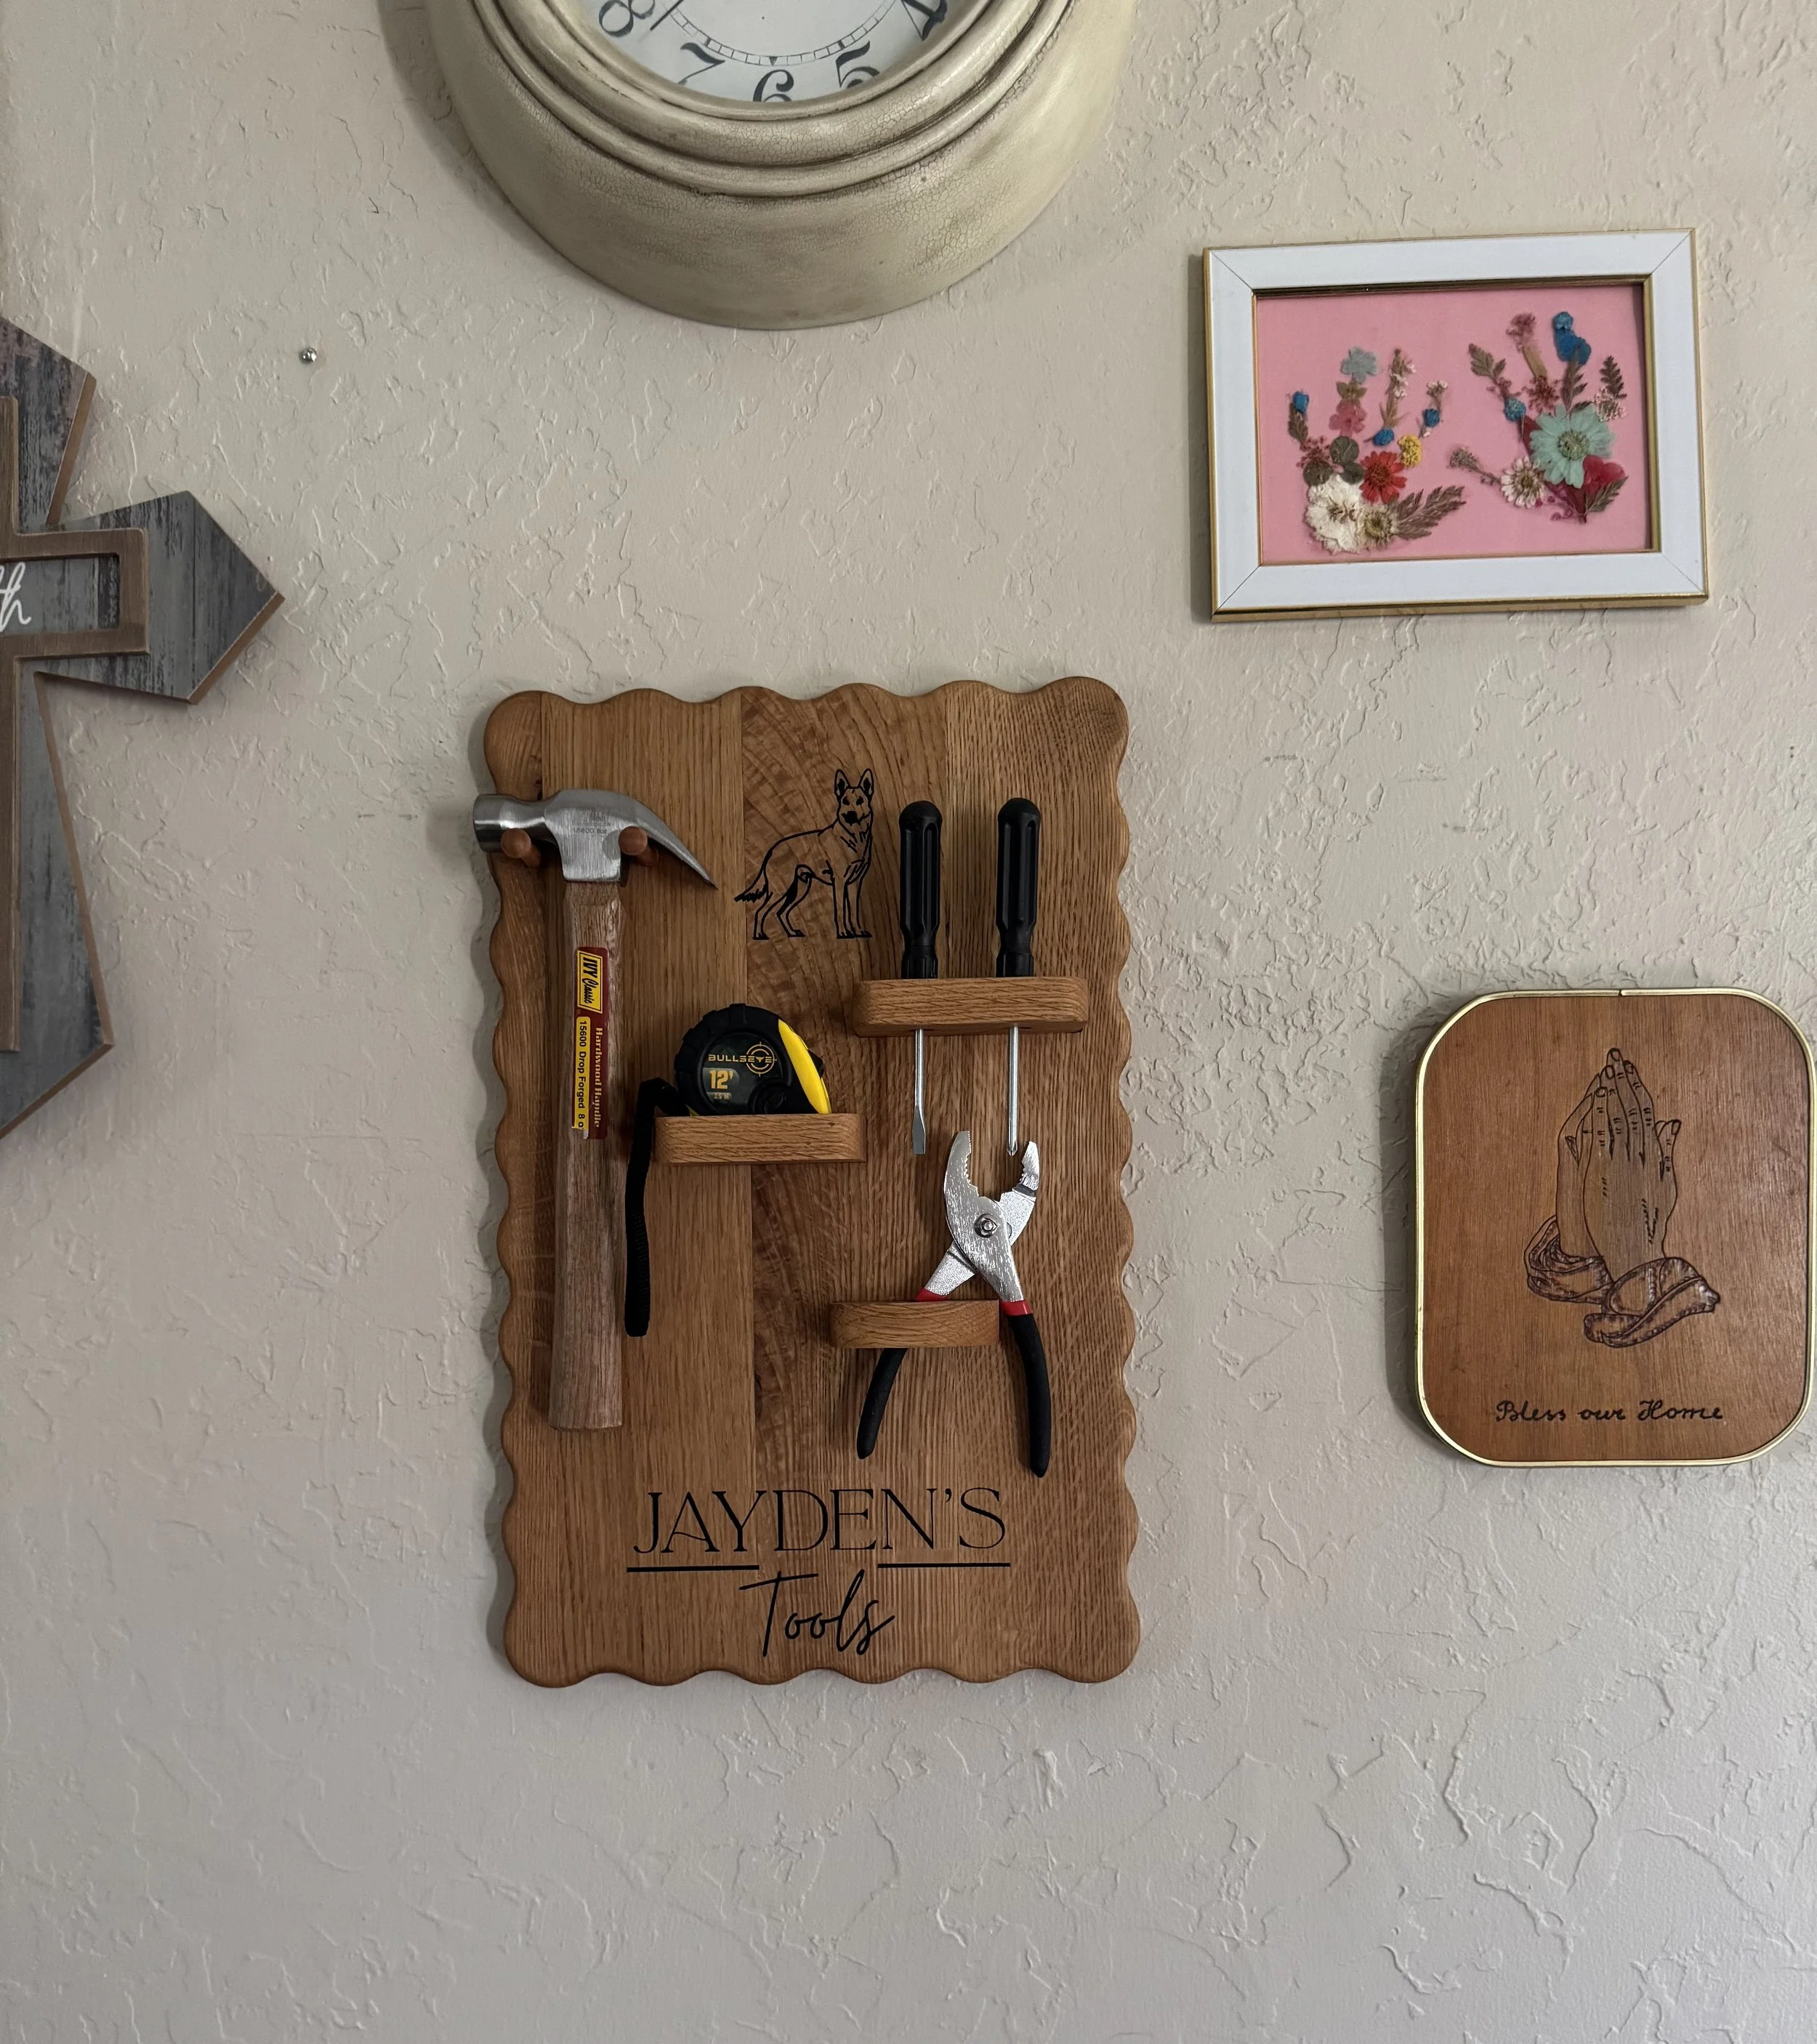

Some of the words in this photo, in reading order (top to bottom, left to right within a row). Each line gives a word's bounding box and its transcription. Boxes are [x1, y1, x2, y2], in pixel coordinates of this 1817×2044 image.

[599, 0, 656, 38] 8
[678, 42, 726, 85] 7
[836, 41, 881, 88] 5
[752, 69, 794, 102] 6
[583, 956, 598, 979] IVY
[581, 977, 600, 1004] Classic
[577, 1051, 587, 1074] Drop
[595, 1027, 603, 1086] Hardwood
[708, 1054, 773, 1063] BULLSEYE
[576, 1076, 586, 1109] Forged
[594, 1088, 603, 1128] Handle
[1495, 1399, 1567, 1423] Bless
[1576, 1407, 1627, 1421] our
[1637, 1399, 1724, 1421] Home
[633, 1487, 1006, 1554] JAYDEN'S
[738, 1568, 895, 1657] Tools
